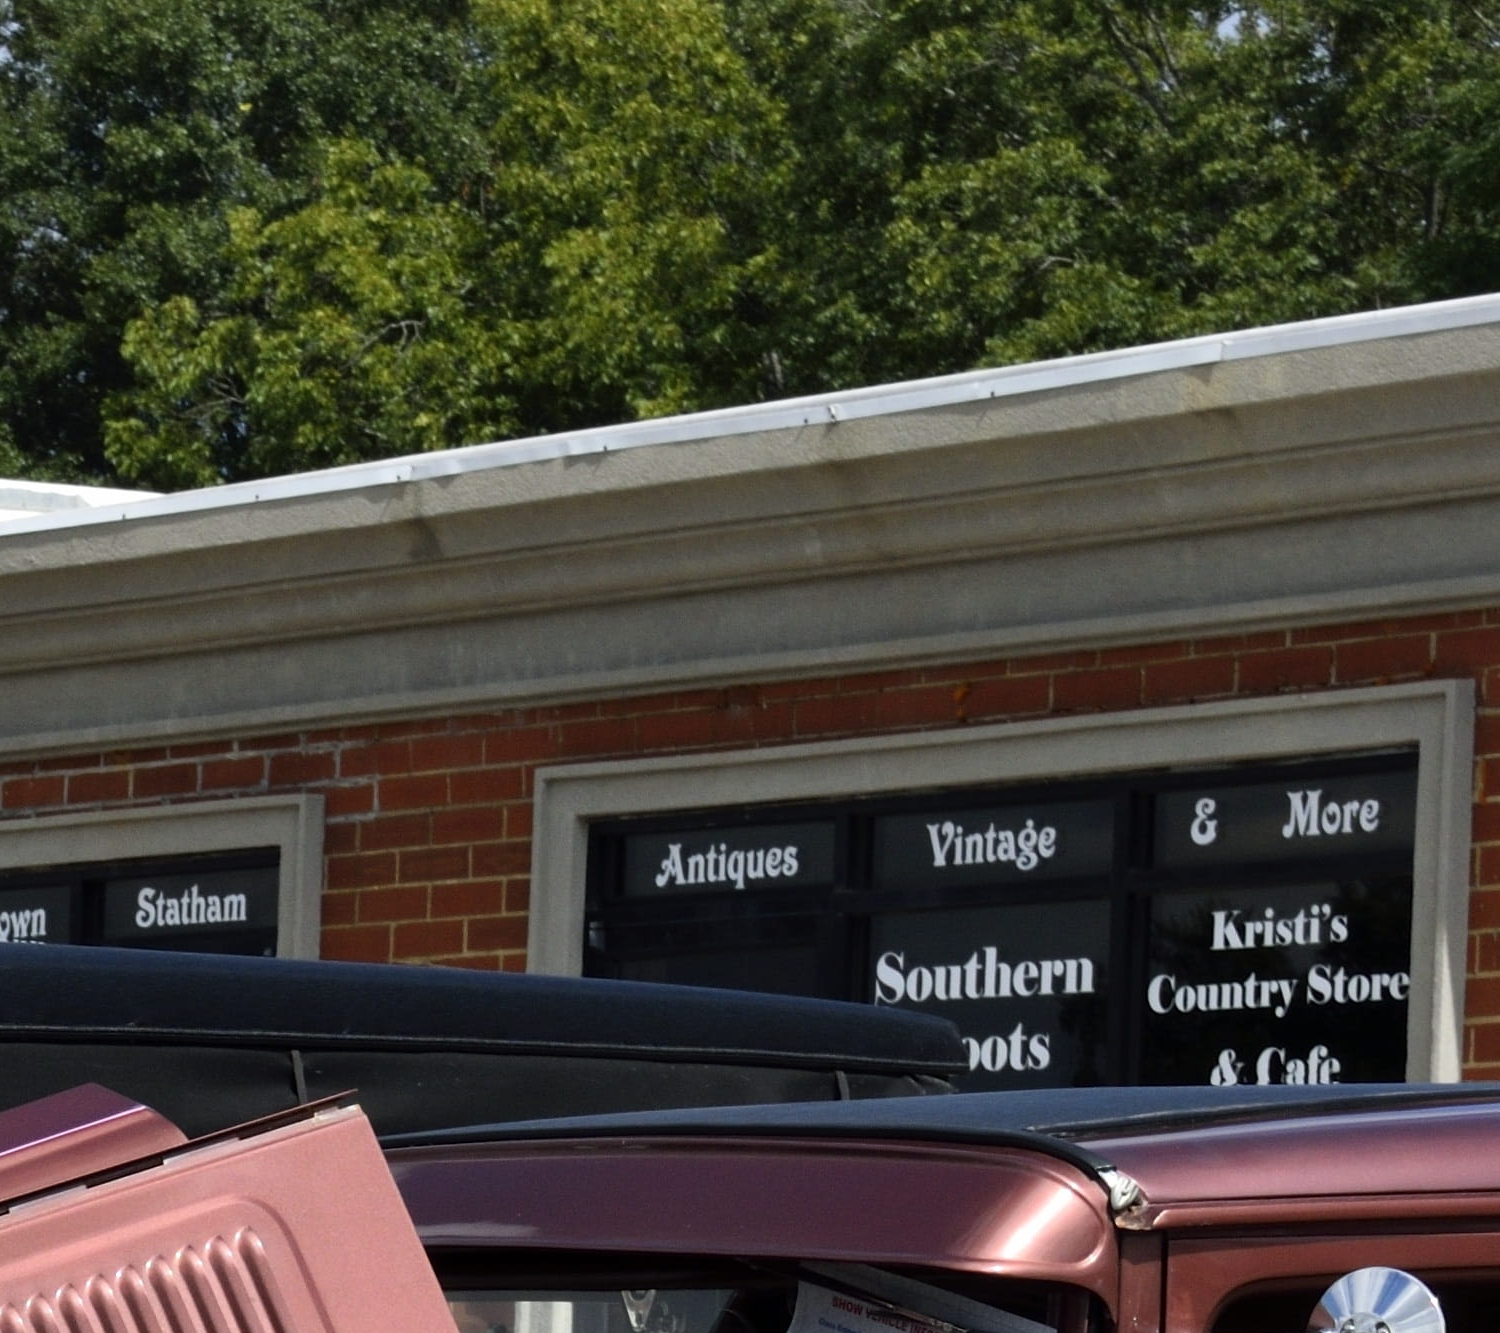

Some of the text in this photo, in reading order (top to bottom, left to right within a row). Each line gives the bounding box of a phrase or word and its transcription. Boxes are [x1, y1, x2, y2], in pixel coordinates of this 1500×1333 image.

[655, 788, 1380, 890] Antiques Vintage & More
[135, 885, 247, 929] Statham
[1210, 903, 1349, 951] Kristi's
[875, 946, 1095, 1006] Southern
[1147, 963, 1410, 1018] Country Store
[962, 1022, 1050, 1072] oots
[831, 1296, 863, 1317] SHOW
